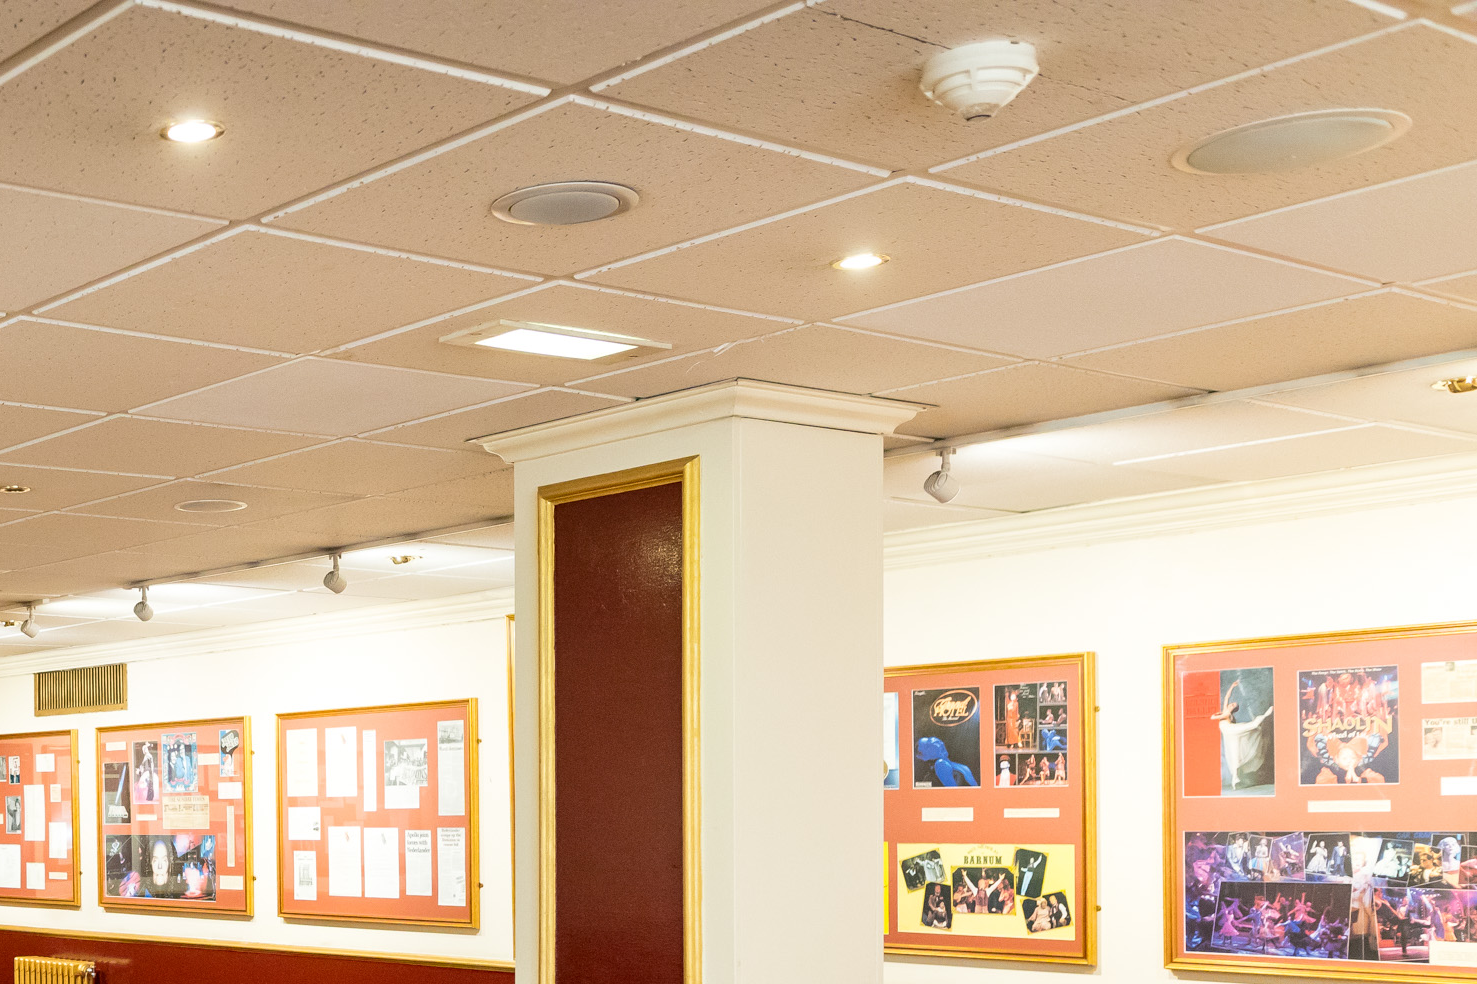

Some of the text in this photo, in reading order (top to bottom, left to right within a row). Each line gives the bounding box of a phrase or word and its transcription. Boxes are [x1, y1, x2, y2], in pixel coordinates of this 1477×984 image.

[933, 705, 969, 717] HOTEL
[1302, 714, 1393, 737] SHAOLIN
[1424, 719, 1450, 727] You're
[964, 855, 1002, 865] BARNUM
